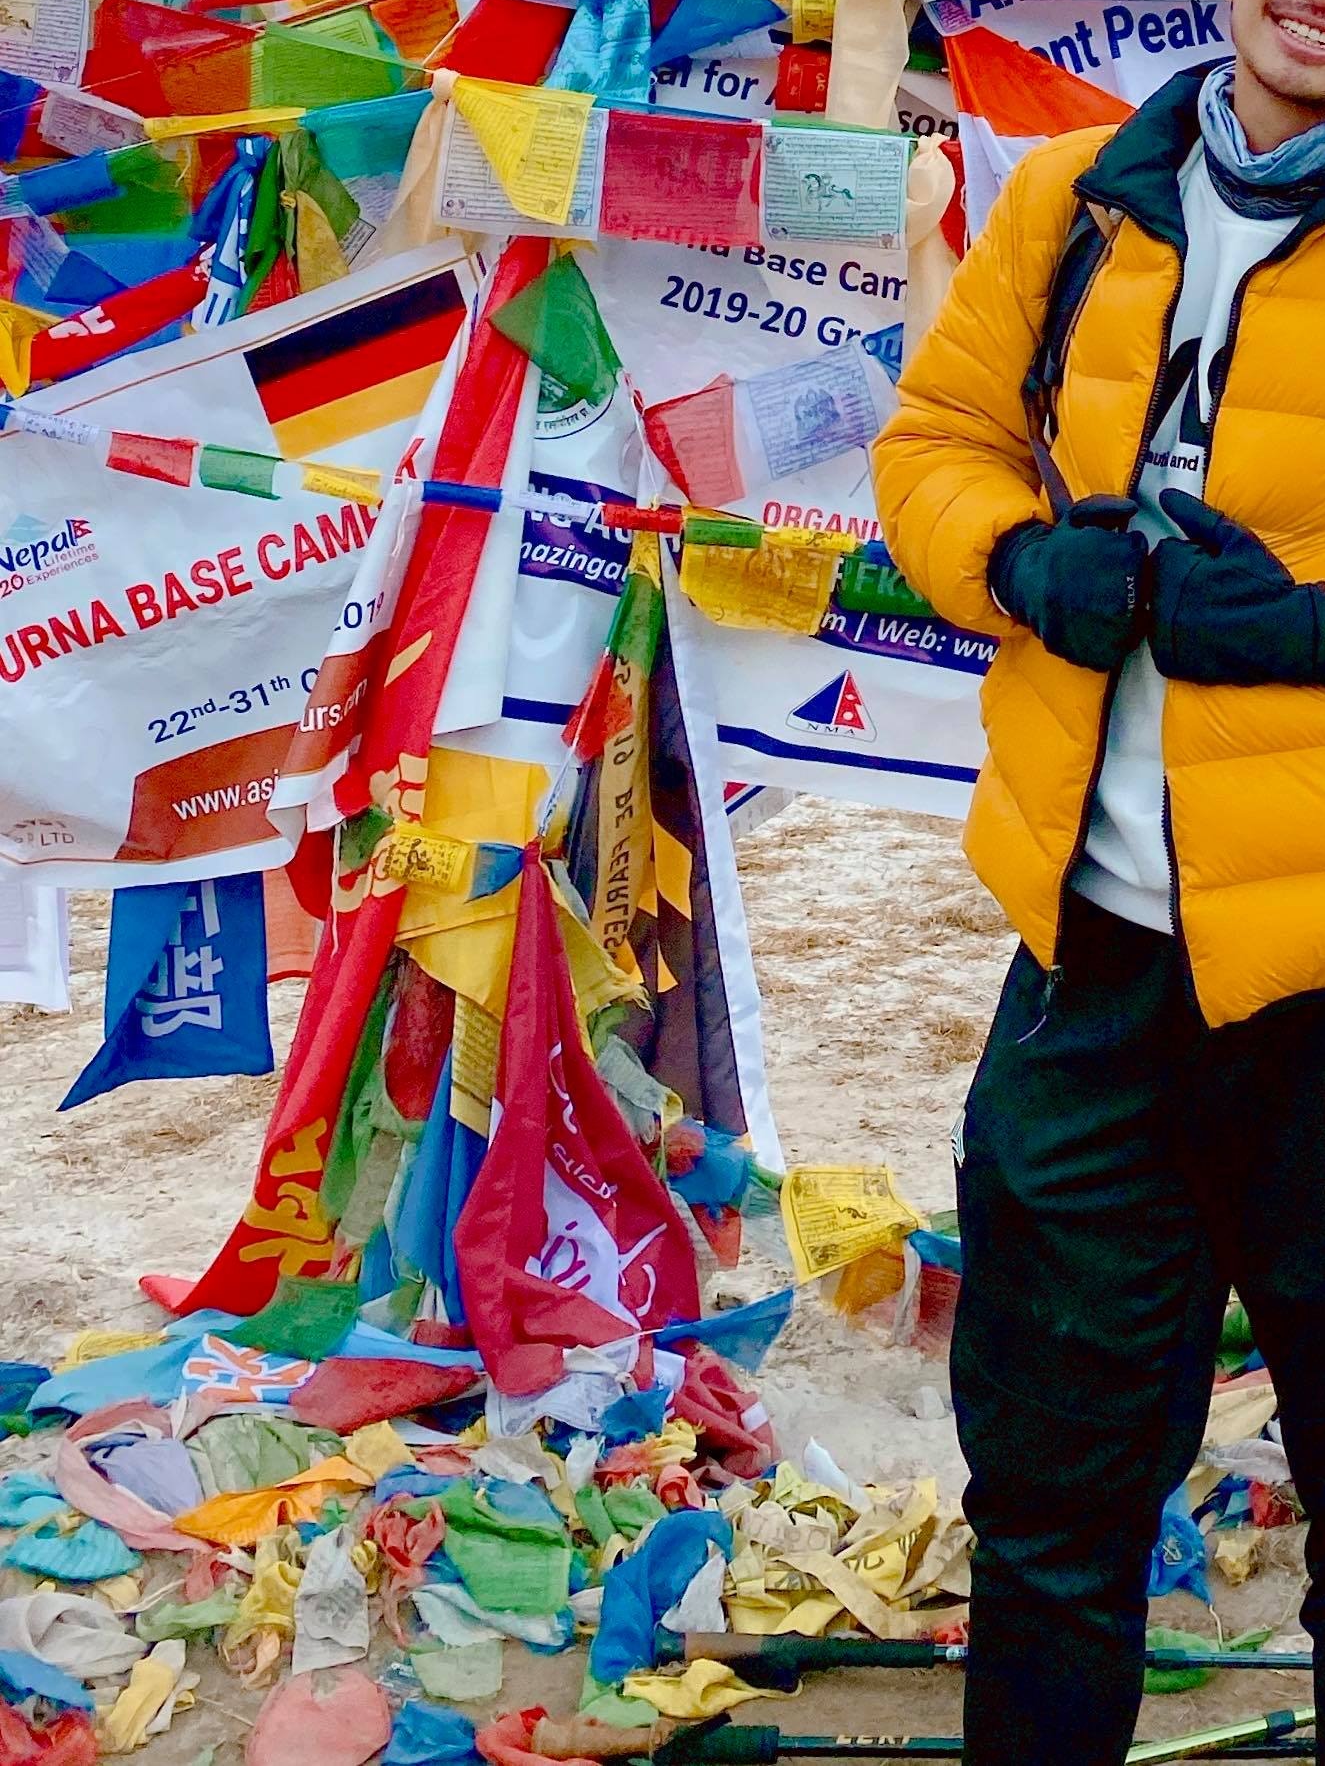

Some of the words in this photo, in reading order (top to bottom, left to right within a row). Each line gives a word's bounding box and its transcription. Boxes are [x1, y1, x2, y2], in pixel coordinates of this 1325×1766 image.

[1103, 0, 1225, 60] Peak
[703, 60, 759, 101] for
[743, 242, 828, 287] Base
[839, 261, 908, 302] Cam
[660, 275, 808, 338] 2019-20
[763, 501, 885, 541] ORGANI
[26, 553, 100, 585] Experiences
[43, 543, 96, 567] Lifetime
[0, 600, 125, 683] URNA
[125, 546, 254, 631] BASE
[876, 616, 947, 653] Web:
[807, 722, 856, 736] NMA
